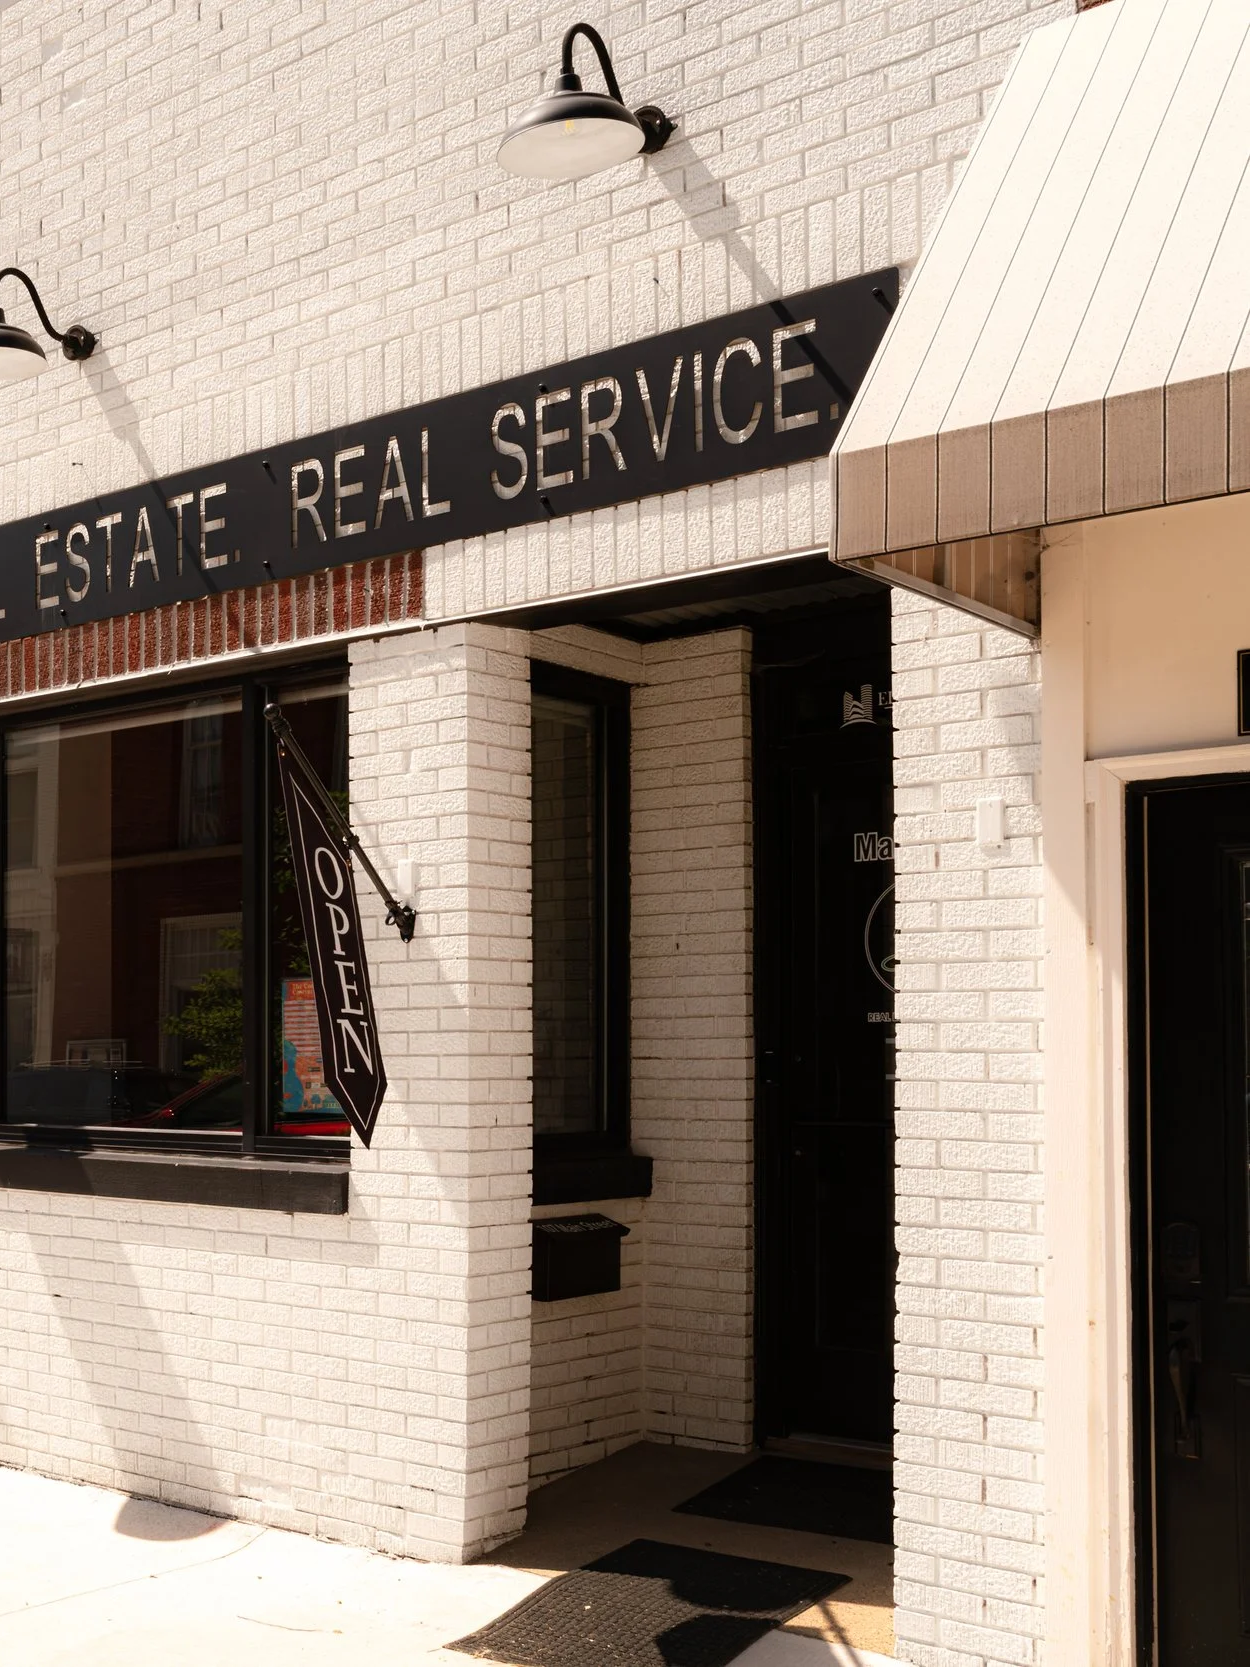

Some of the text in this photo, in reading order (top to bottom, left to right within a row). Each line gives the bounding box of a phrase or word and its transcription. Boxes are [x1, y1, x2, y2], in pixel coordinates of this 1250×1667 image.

[34, 483, 241, 610] ESTATE.
[290, 427, 451, 549] REAL
[490, 318, 840, 501] SERVICE.
[854, 831, 894, 862] Ma
[314, 846, 374, 1077] OPEN
[867, 1012, 891, 1023] REAL
